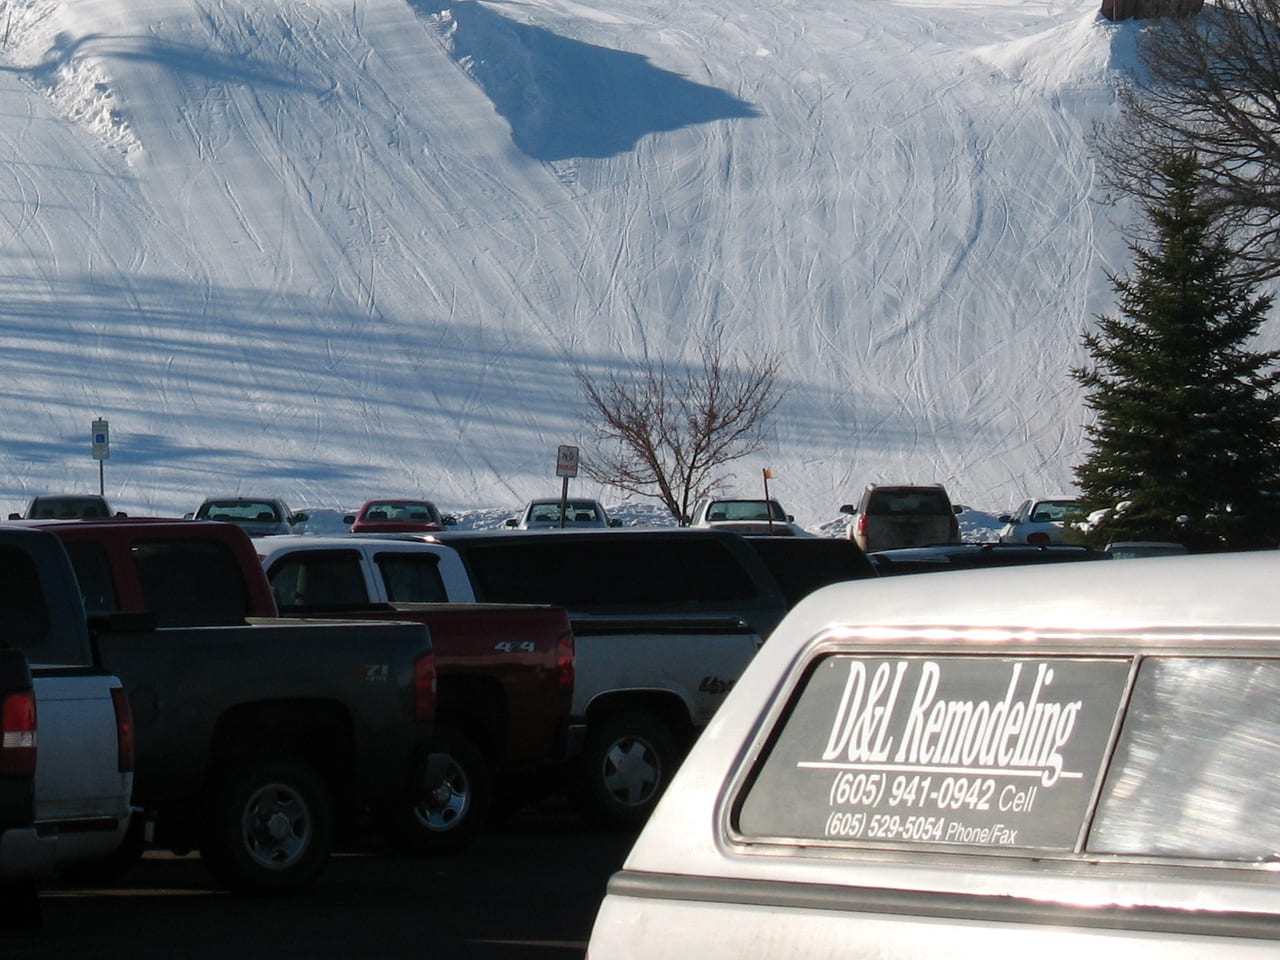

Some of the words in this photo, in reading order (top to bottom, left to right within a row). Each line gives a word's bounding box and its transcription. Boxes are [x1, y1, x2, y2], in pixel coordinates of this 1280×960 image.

[822, 661, 908, 762] D&L
[894, 661, 1082, 787] Remodeling
[829, 771, 886, 808] (605)
[889, 776, 995, 810] 941-0942
[999, 785, 1037, 812] Cell
[825, 811, 866, 837] (605)
[868, 815, 945, 840] 529-5054
[945, 822, 1018, 844] Phone/Fax
